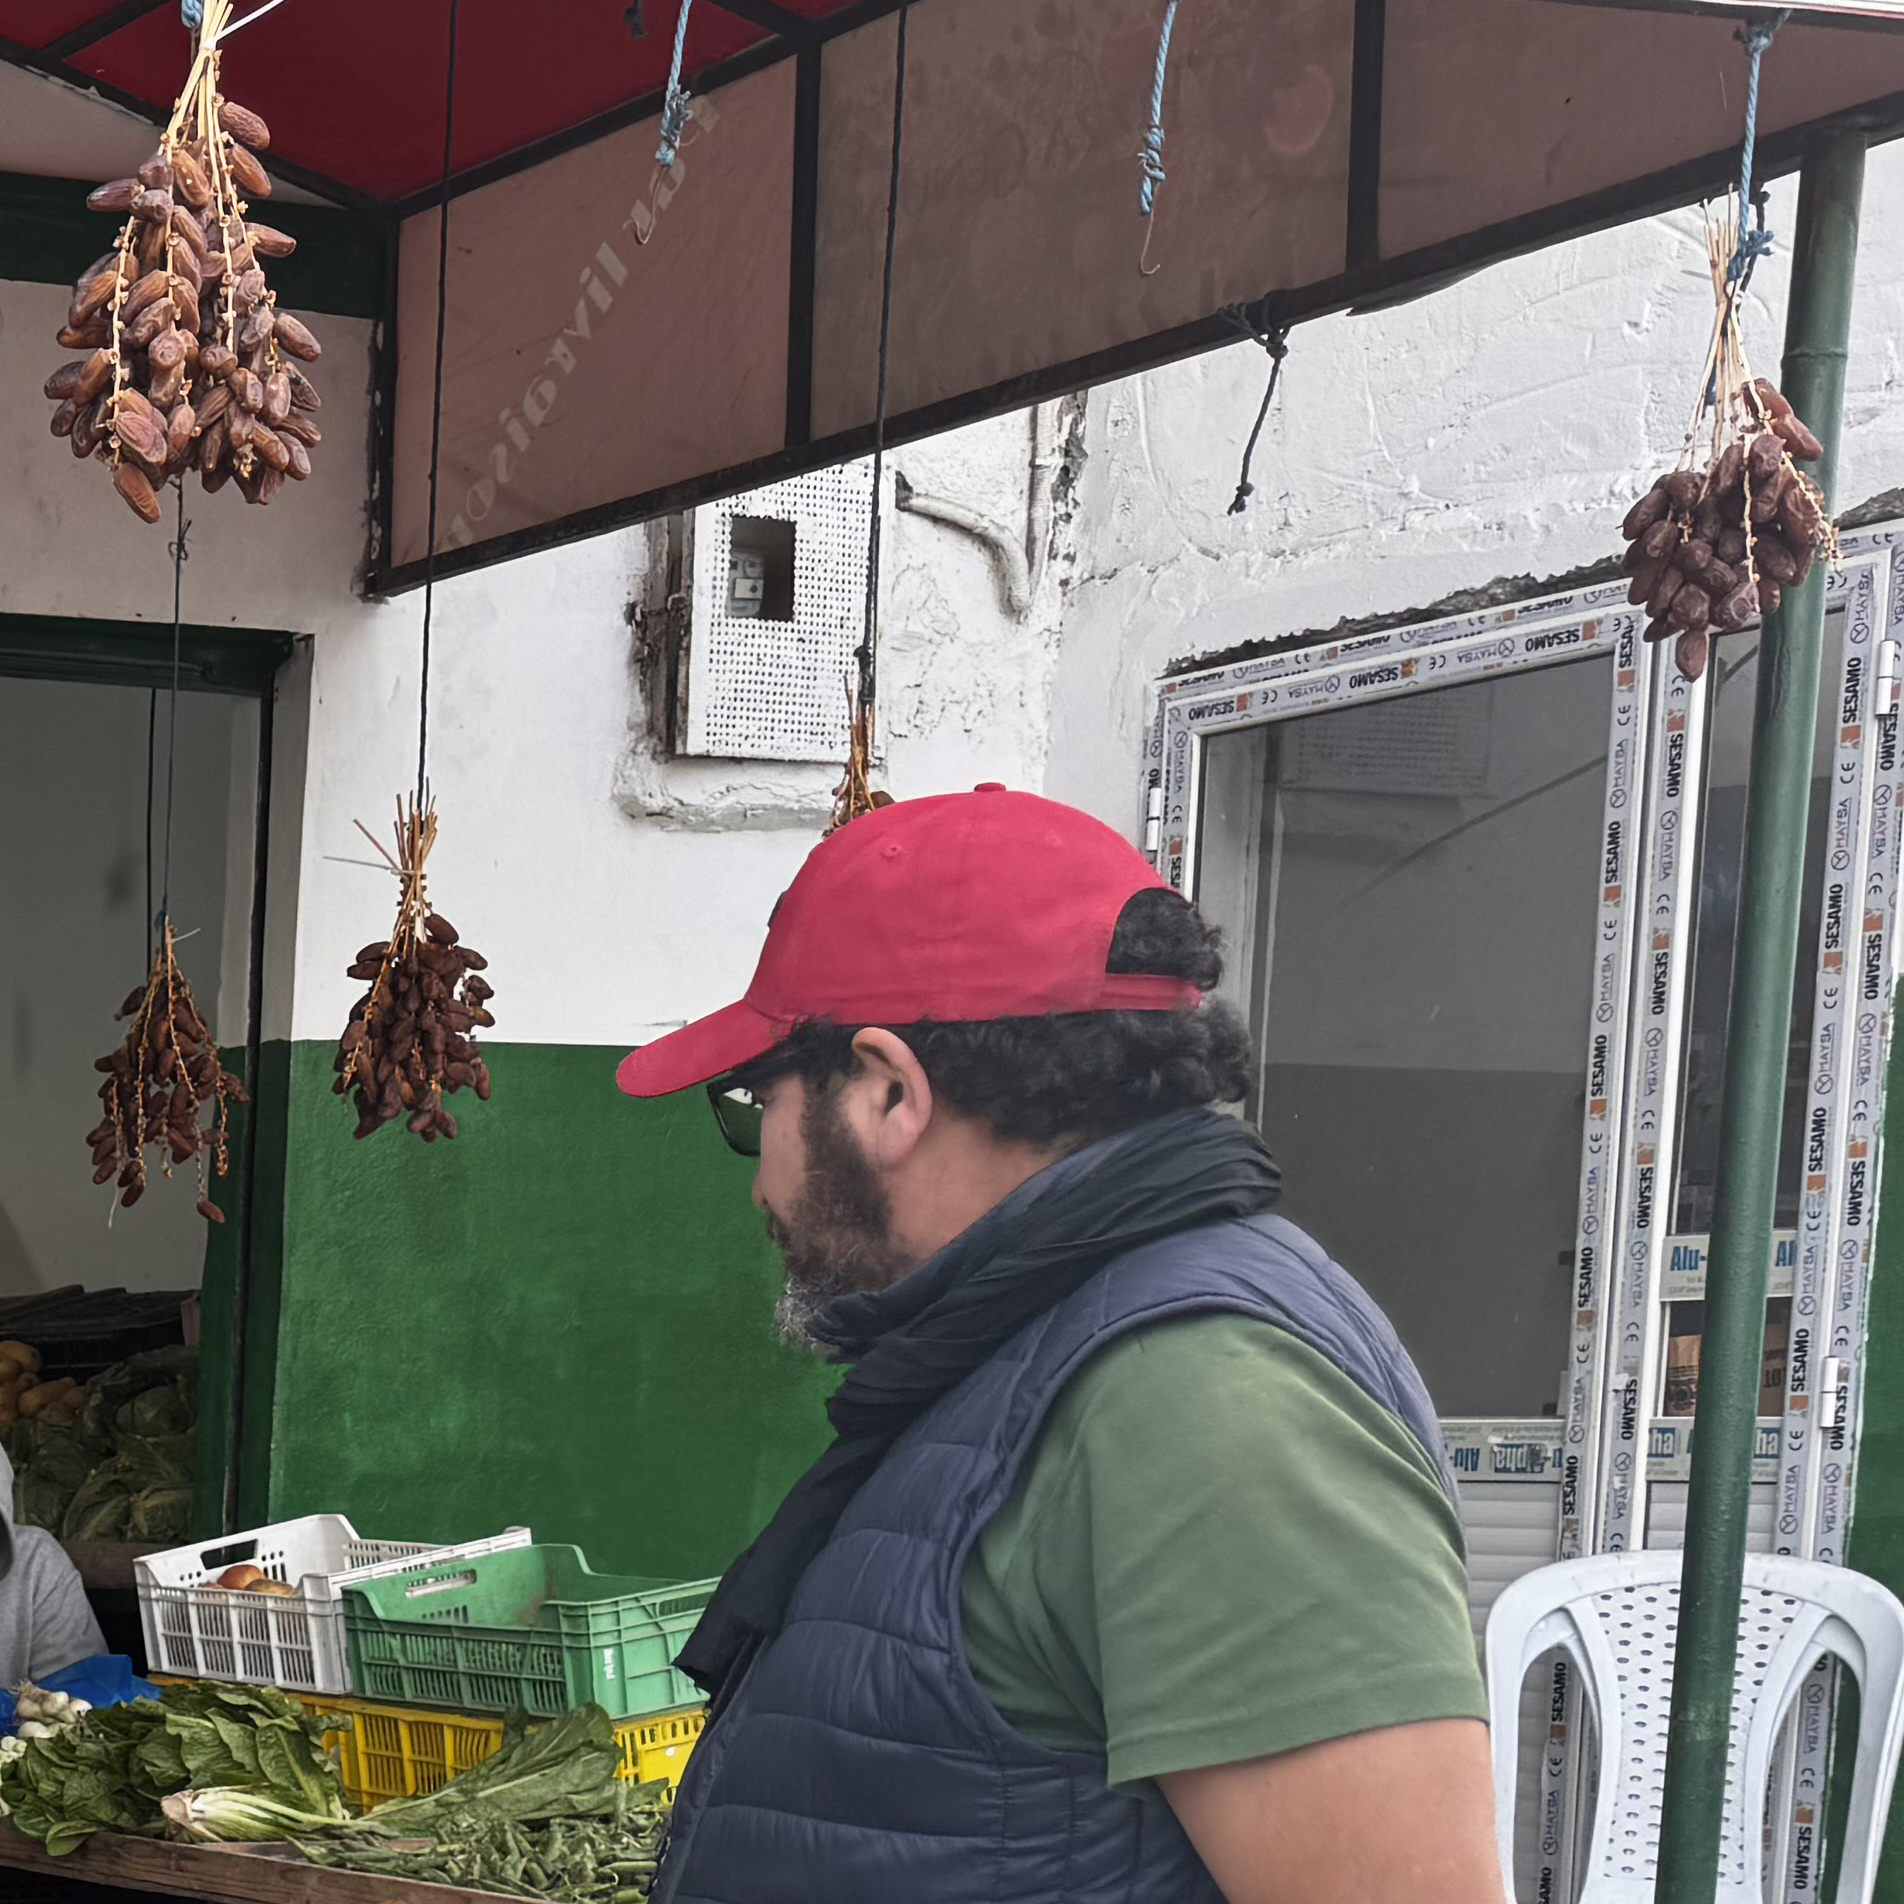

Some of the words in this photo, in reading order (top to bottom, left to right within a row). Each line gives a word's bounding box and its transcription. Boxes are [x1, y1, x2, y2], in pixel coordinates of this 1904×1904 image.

[1525, 628, 1581, 652] SESAMO
[1349, 666, 1400, 690] SESAMO
[1188, 700, 1235, 721] SESAMO
[1666, 734, 1684, 798] SESAMO
[1652, 952, 1669, 1016] SESAMO
[1864, 932, 1882, 1000] SESAMO
[1791, 1328, 1810, 1393] SESAMO
[1808, 1106, 1828, 1172] SESAMO
[1824, 883, 1844, 950] SESAMO
[1842, 656, 1862, 725] SESAMO
[1562, 1454, 1580, 1516] SESAMO
[1577, 1246, 1594, 1308] SESAMO
[1590, 1034, 1608, 1098] SESAMO
[1604, 820, 1622, 884] SESAMO
[1636, 1166, 1654, 1229] SESAMO
[1846, 1160, 1866, 1226] SESAMO
[1620, 1378, 1638, 1440] SESAMO
[1551, 1662, 1566, 1722] SESAMO
[1794, 1826, 1812, 1890] SESAMO
